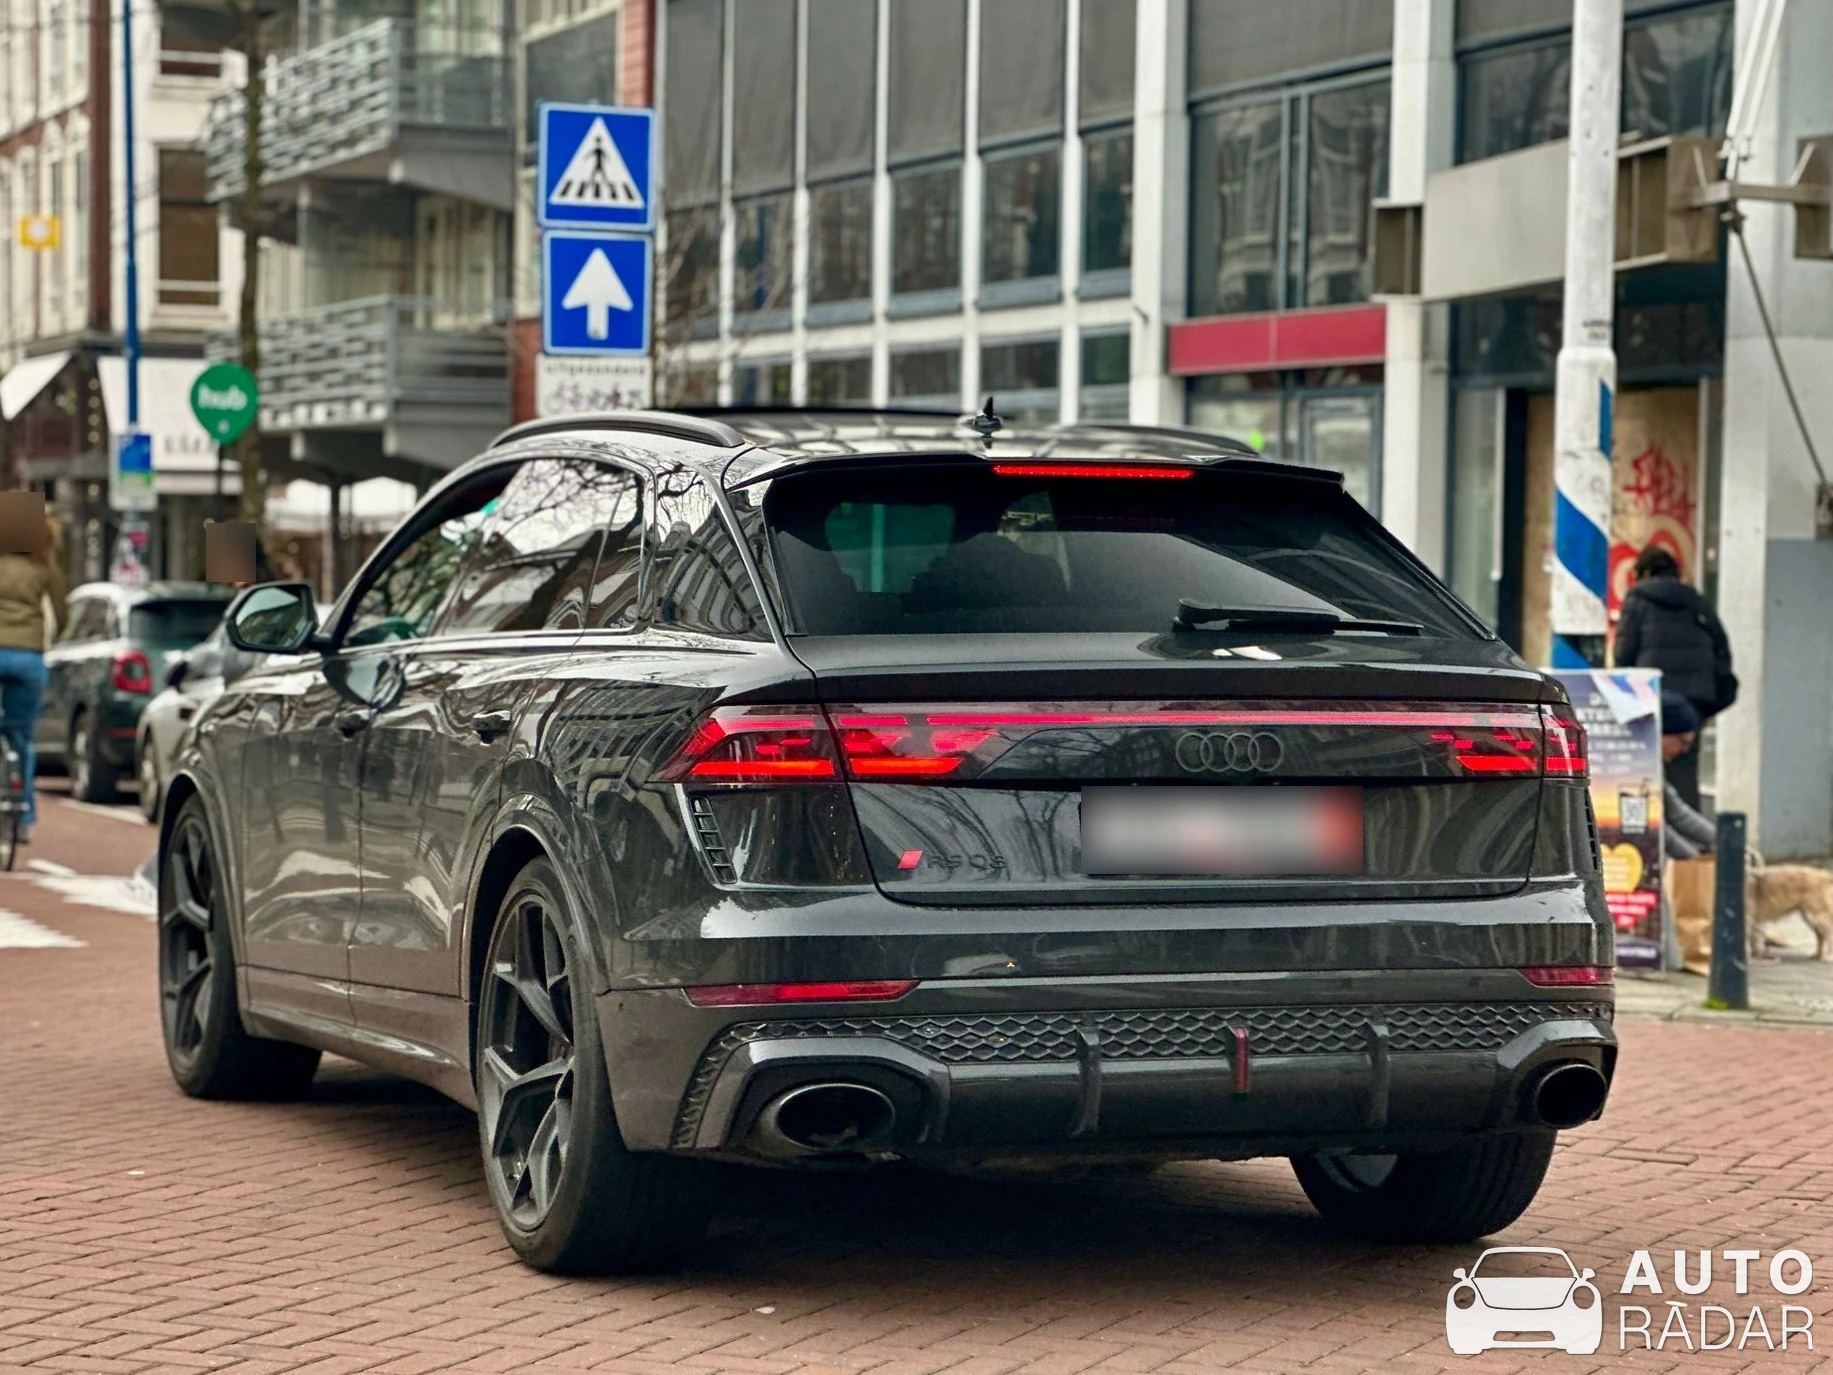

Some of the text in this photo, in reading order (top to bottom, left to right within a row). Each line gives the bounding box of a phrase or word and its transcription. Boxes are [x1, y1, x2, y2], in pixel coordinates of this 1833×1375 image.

[198, 383, 248, 411] hub
[927, 854, 1007, 871] RS Q8
